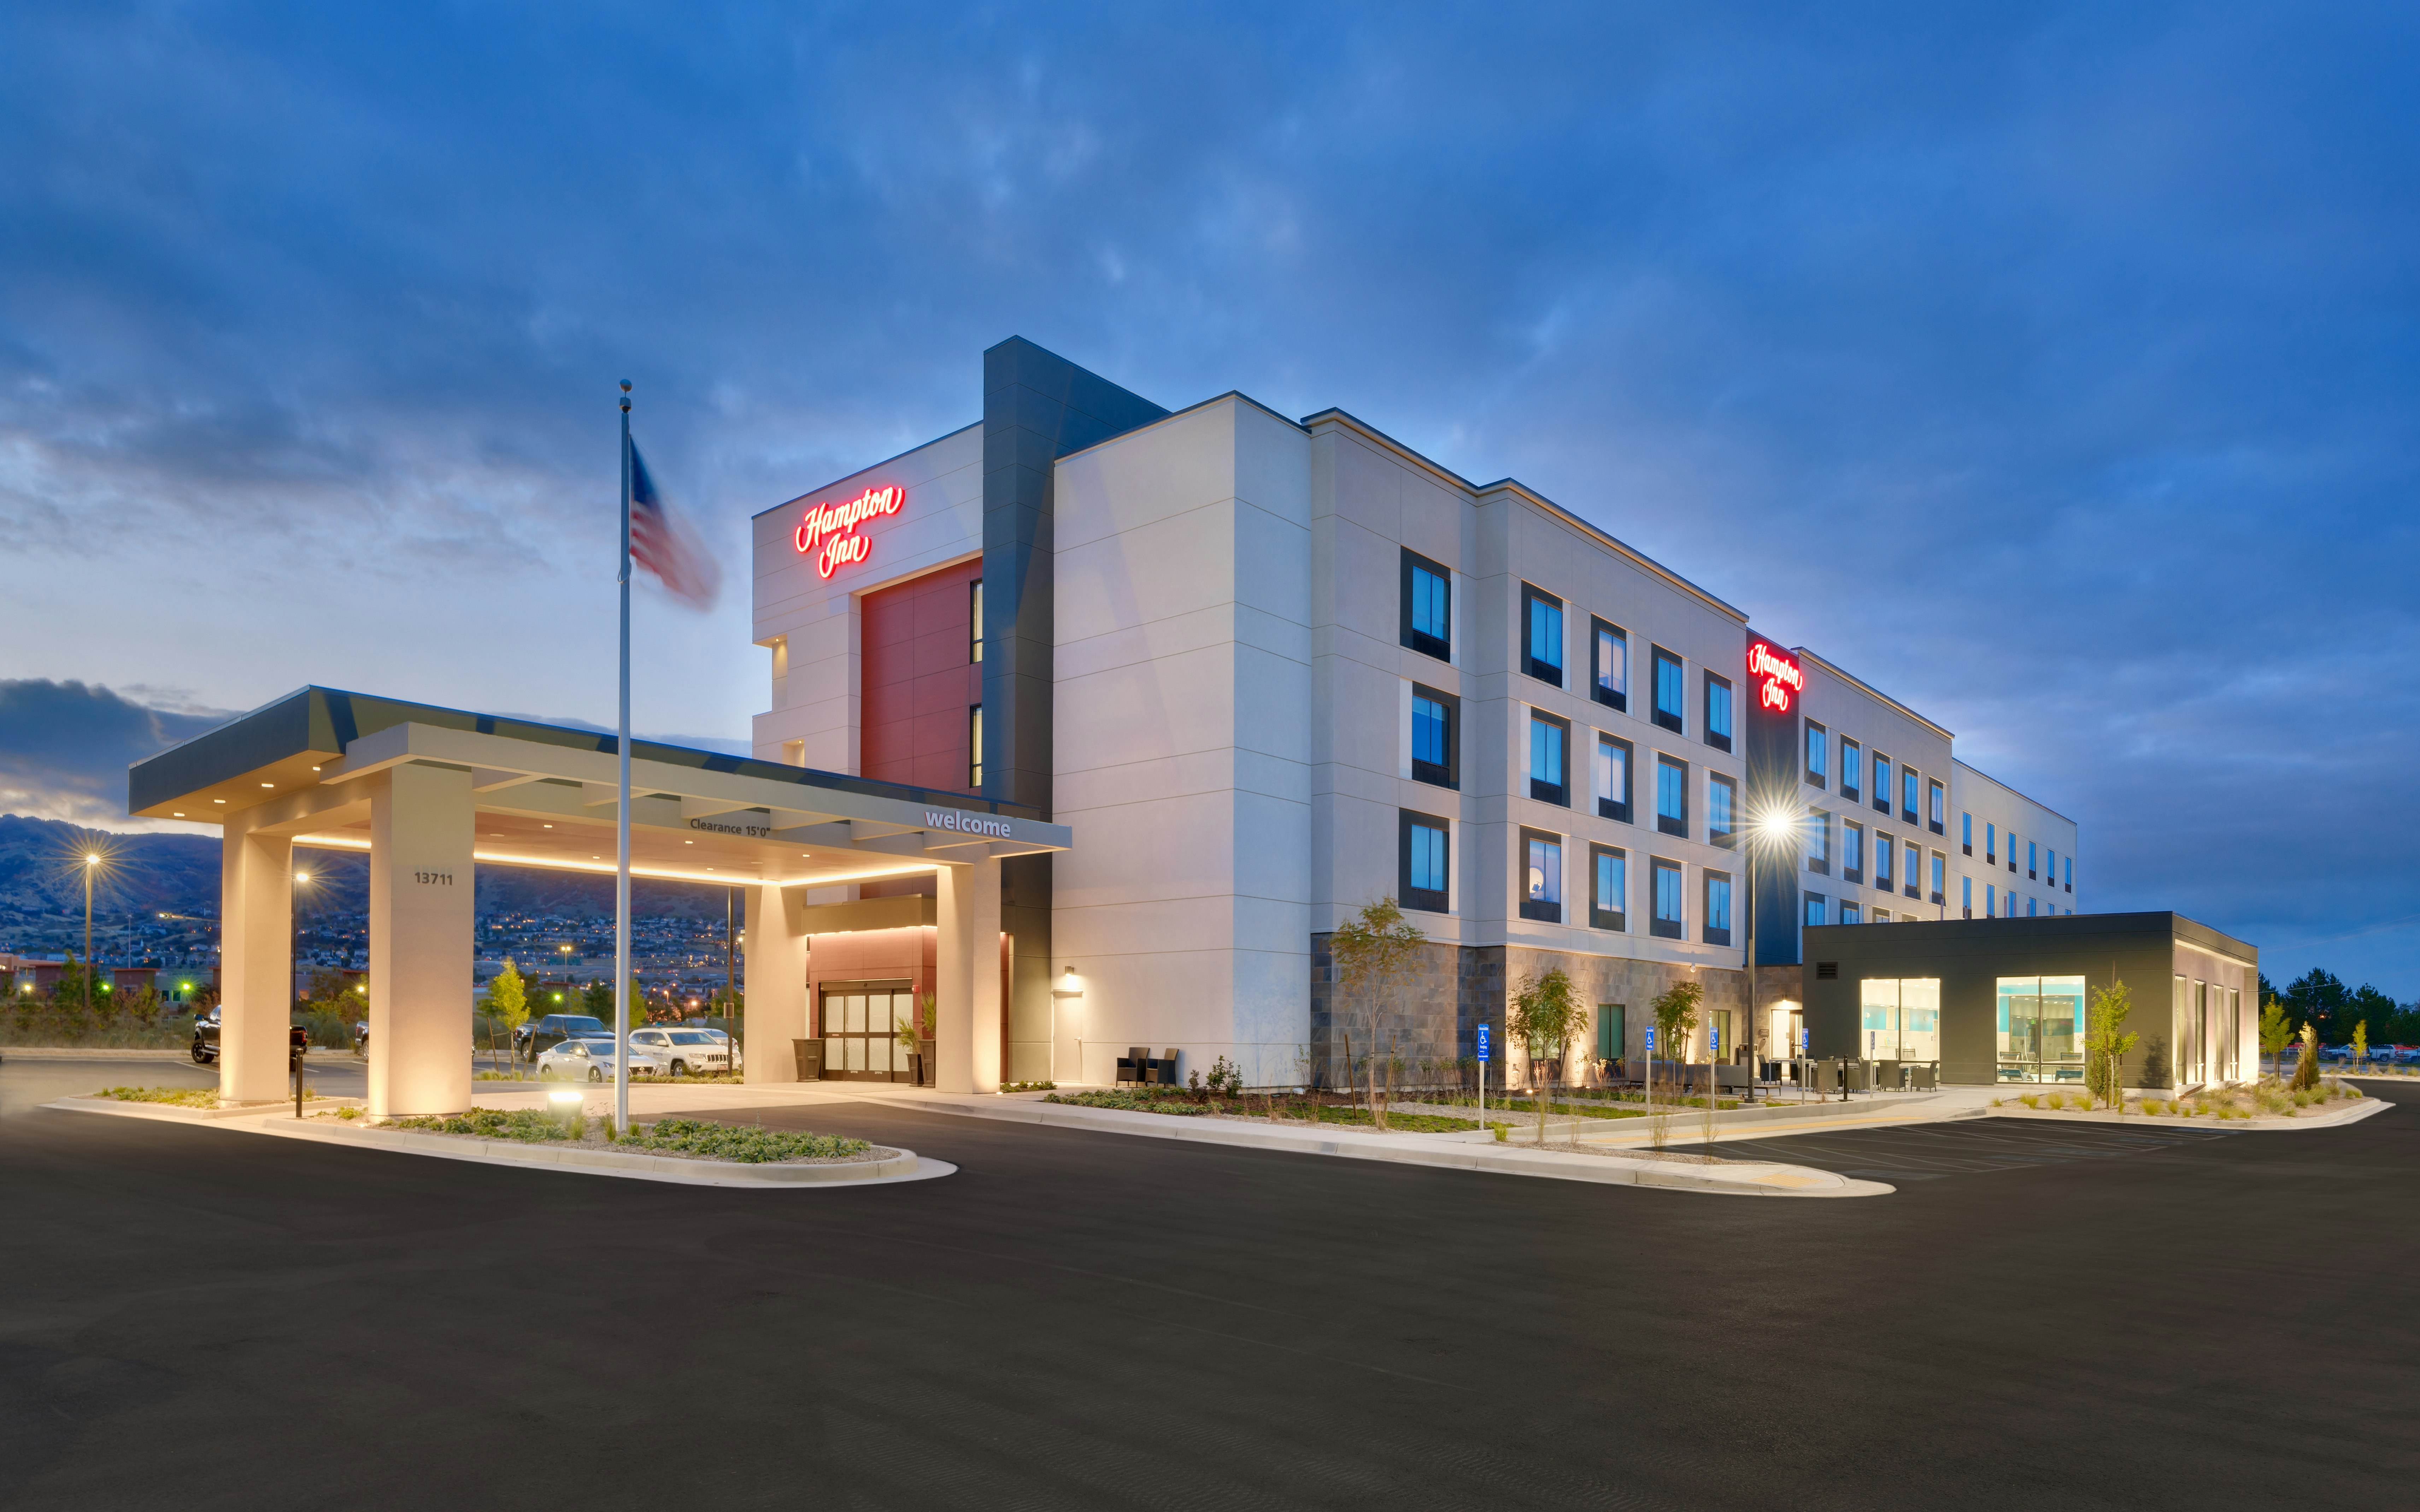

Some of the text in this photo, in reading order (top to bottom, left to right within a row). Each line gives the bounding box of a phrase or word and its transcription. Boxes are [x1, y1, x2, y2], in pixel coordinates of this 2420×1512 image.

[796, 487, 905, 553] Hampton
[819, 533, 871, 578] Inn
[1750, 644, 1803, 691] Hampton
[1763, 678, 1788, 711] Inn
[690, 819, 742, 834] Clearance
[924, 811, 1011, 837] welcome
[415, 872, 452, 886] 13711
